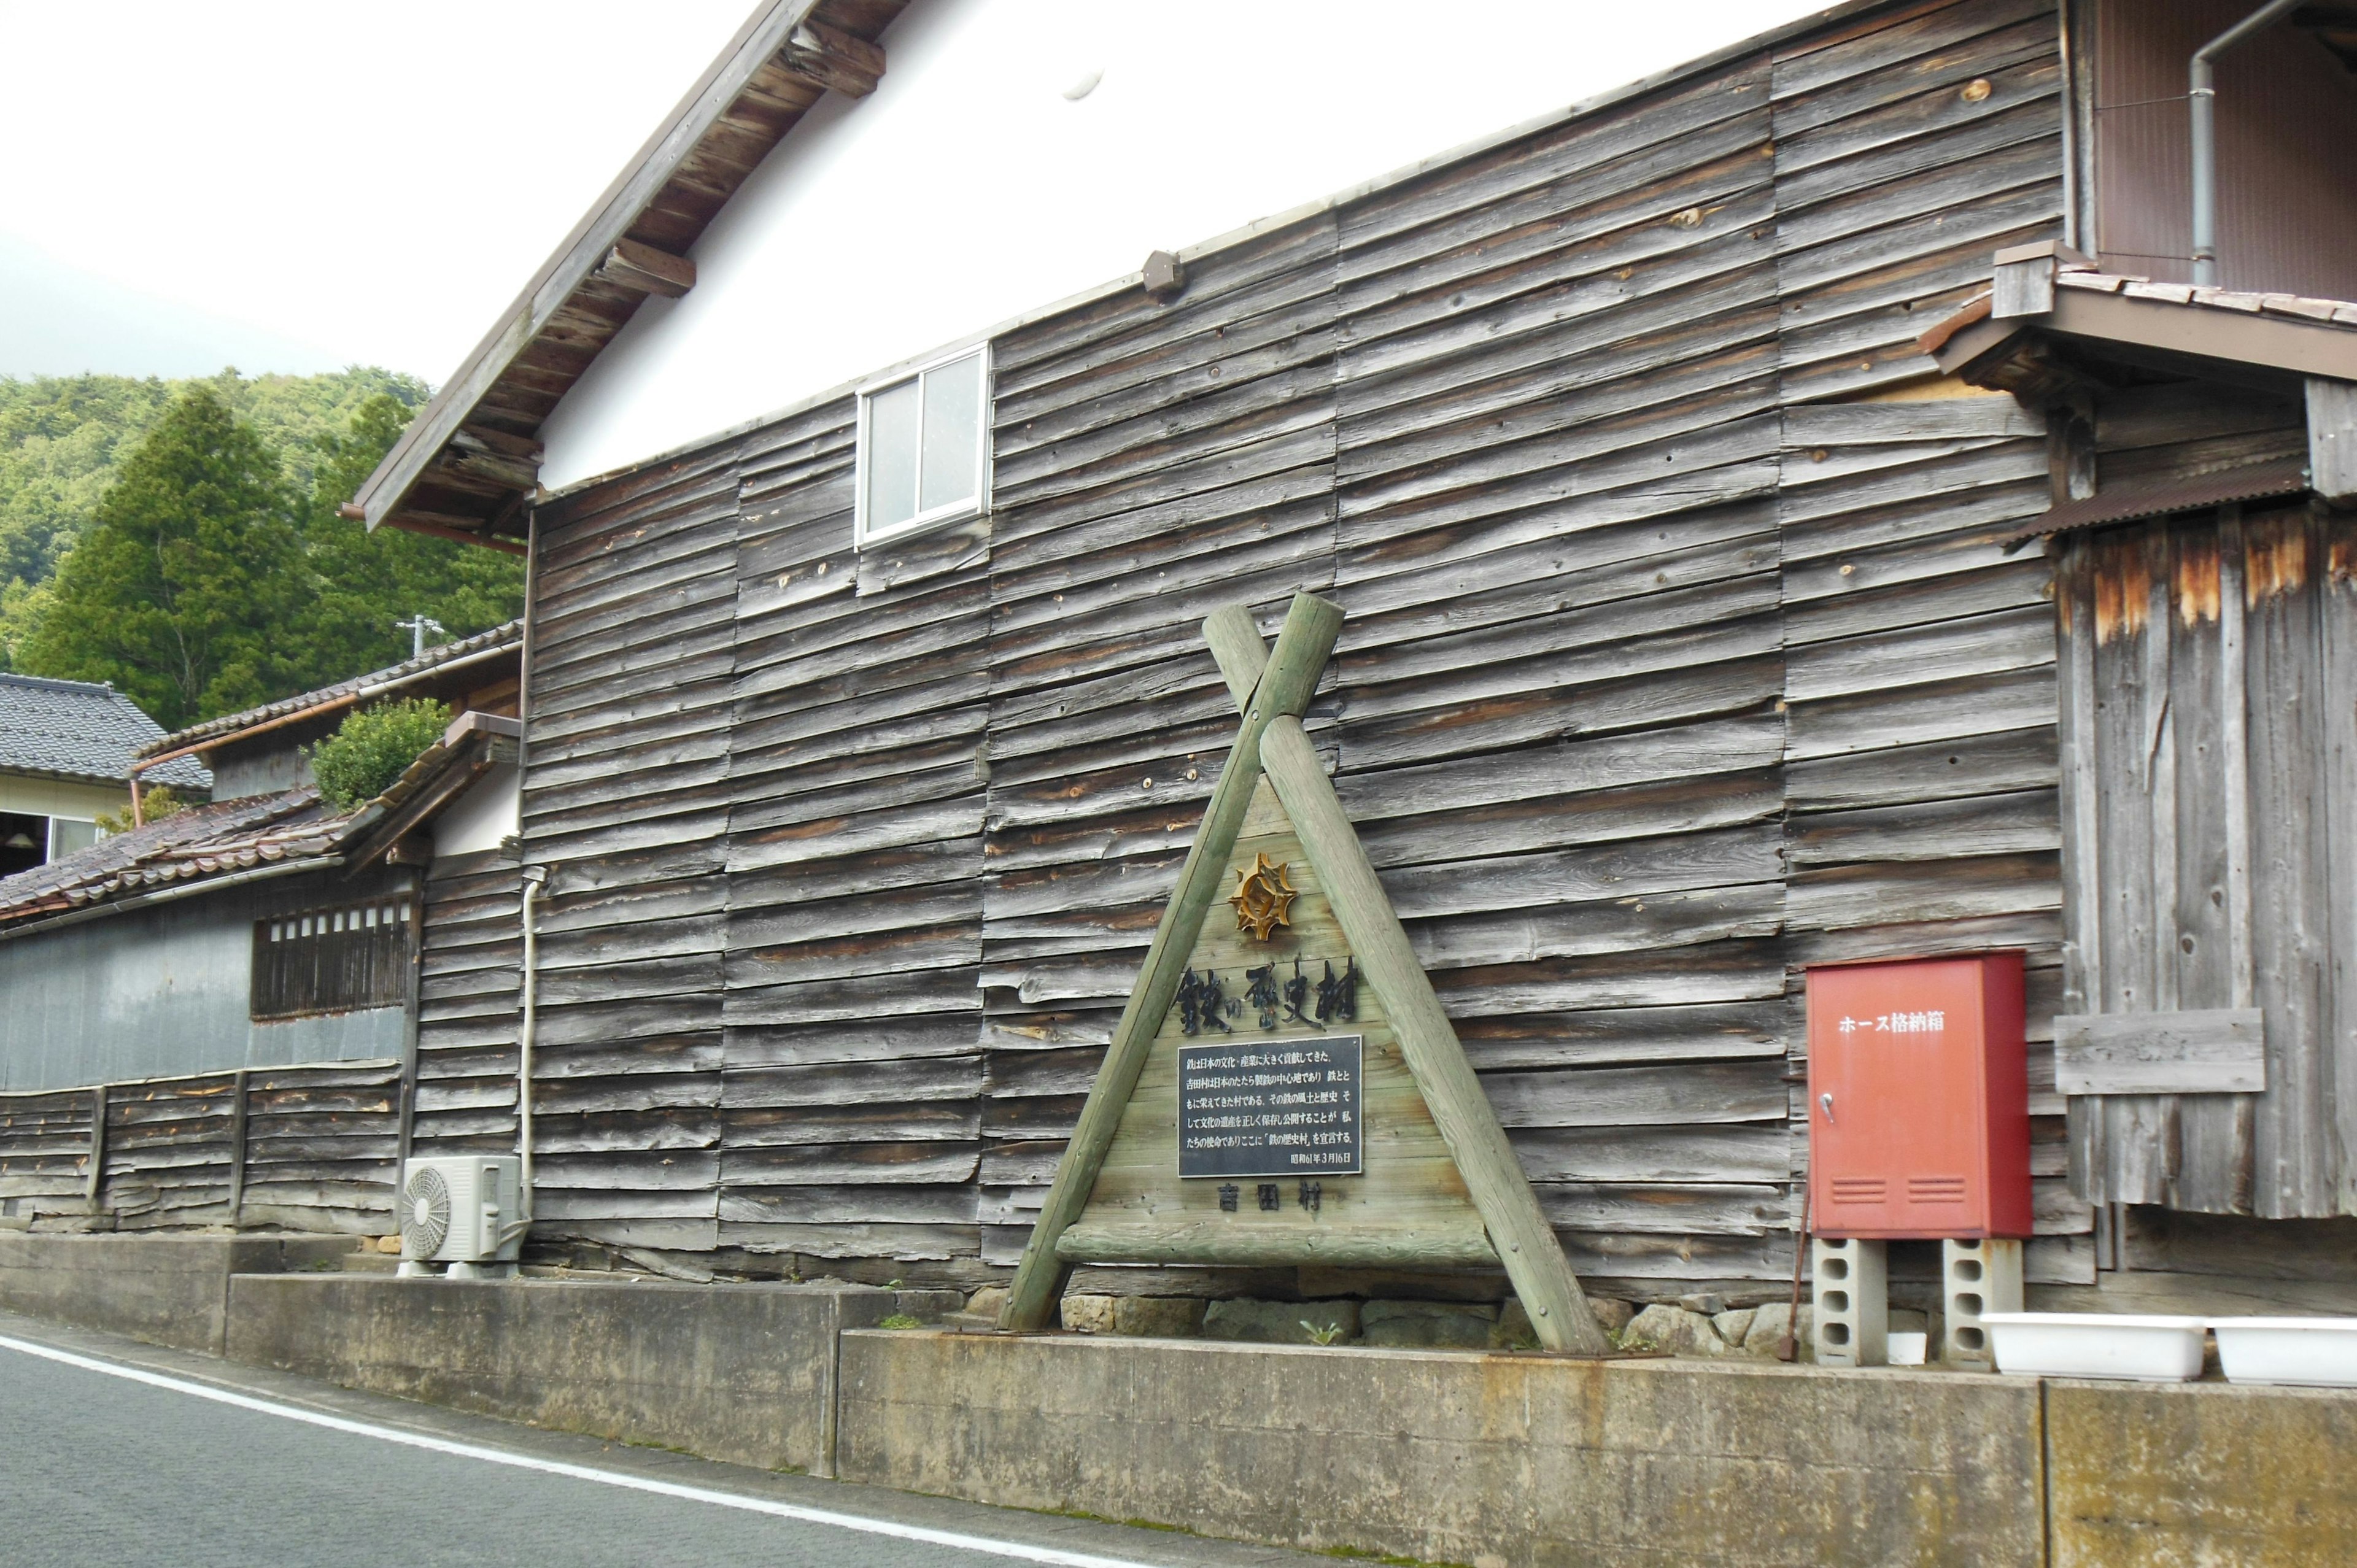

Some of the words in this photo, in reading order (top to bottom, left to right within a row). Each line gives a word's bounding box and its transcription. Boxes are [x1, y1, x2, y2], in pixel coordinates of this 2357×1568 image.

[1840, 1011, 1945, 1032] ホース格納箱
